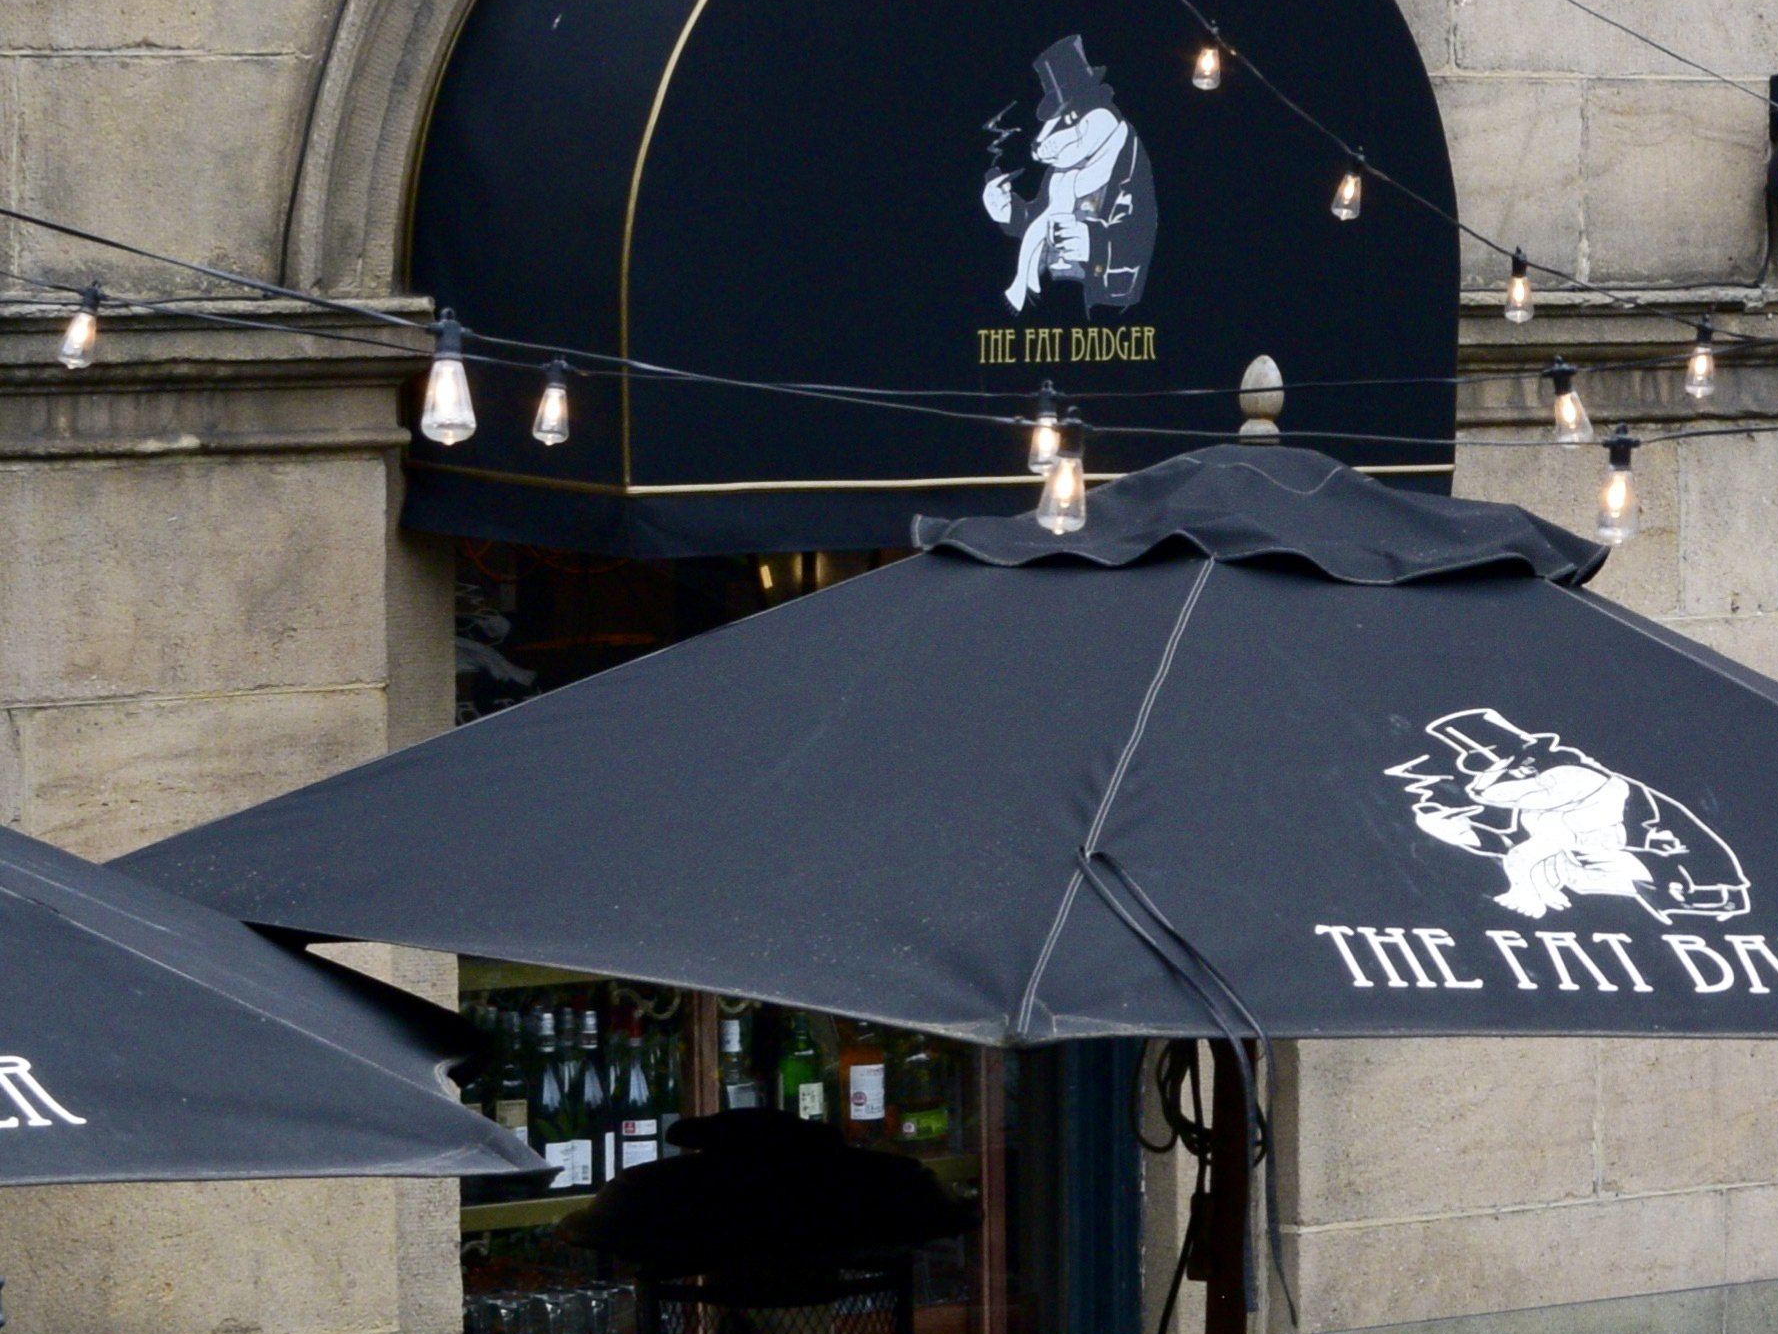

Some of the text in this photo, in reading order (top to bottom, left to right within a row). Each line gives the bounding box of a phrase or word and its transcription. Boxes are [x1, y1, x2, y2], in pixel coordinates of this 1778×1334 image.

[978, 326, 1156, 363] THE FAT BADGER
[1315, 923, 1482, 989] THE
[1485, 929, 1653, 992] FAT
